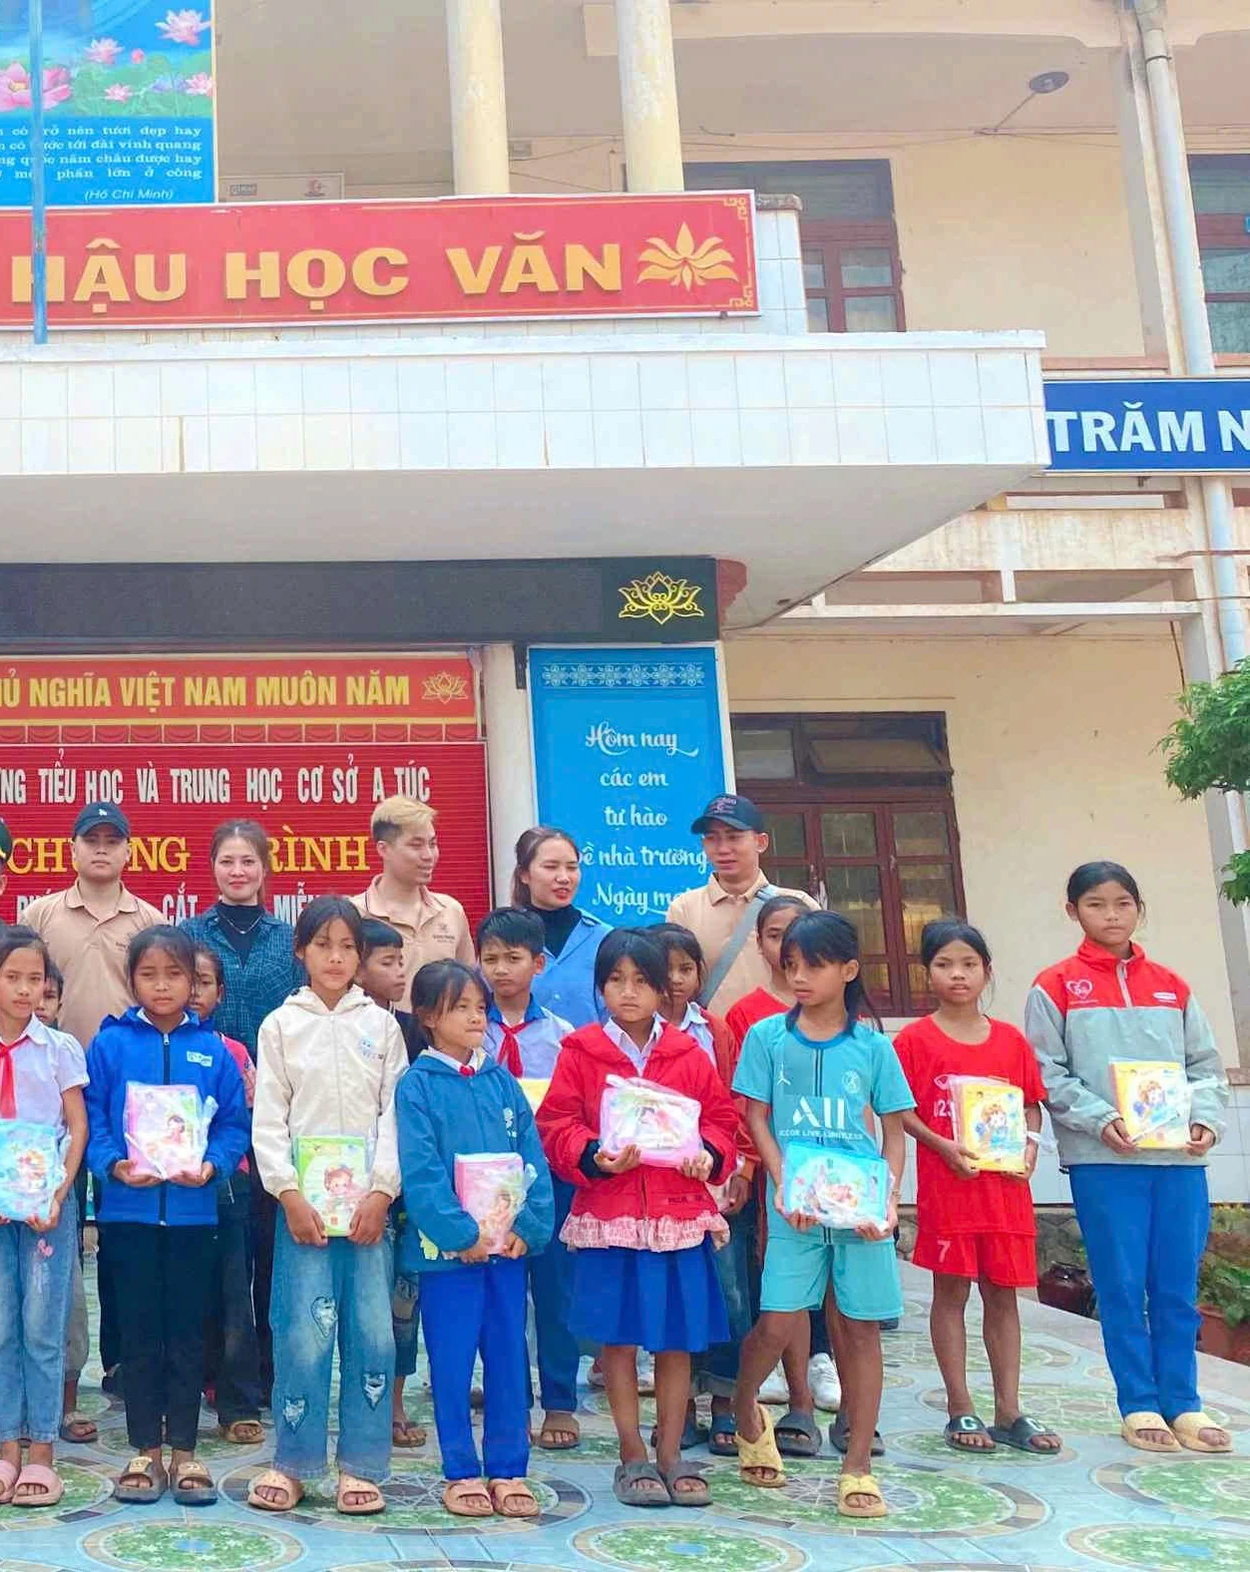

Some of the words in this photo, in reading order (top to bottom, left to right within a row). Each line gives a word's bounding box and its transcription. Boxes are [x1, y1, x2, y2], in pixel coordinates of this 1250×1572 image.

[42, 124, 59, 136] rở
[175, 126, 201, 138] hay
[175, 154, 202, 166] hay
[10, 238, 187, 314] HẬU
[225, 246, 410, 311] HỌC
[446, 230, 622, 296] VĂN
[1046, 401, 1206, 452] TRĂM
[29, 671, 112, 708] NGHĨA
[120, 671, 175, 713] VIỆT
[184, 676, 246, 706] NAM
[256, 670, 337, 707] MUÔN
[346, 671, 410, 707] NĂM
[585, 720, 637, 757] Hôm
[641, 731, 699, 758] nay
[38, 749, 77, 804] TIỂU
[136, 760, 160, 804] VÀ
[170, 767, 230, 804] TRUNG
[246, 767, 283, 811] HỌC
[298, 764, 324, 804] CƠ
[332, 753, 359, 804] SỞ
[372, 766, 386, 803] A
[394, 759, 431, 801] TÚC
[600, 767, 633, 787] các
[639, 772, 669, 787] em
[604, 804, 626, 830] tự
[630, 804, 667, 827] hào
[7, 837, 190, 873] CHNG
[268, 826, 372, 873] RÌNH
[598, 843, 639, 866] nhà
[640, 845, 709, 875] trường
[162, 881, 199, 926] CẮT
[273, 881, 320, 927] MIỄ
[591, 881, 668, 916] Ngày
[936, 1240, 952, 1263] 7
